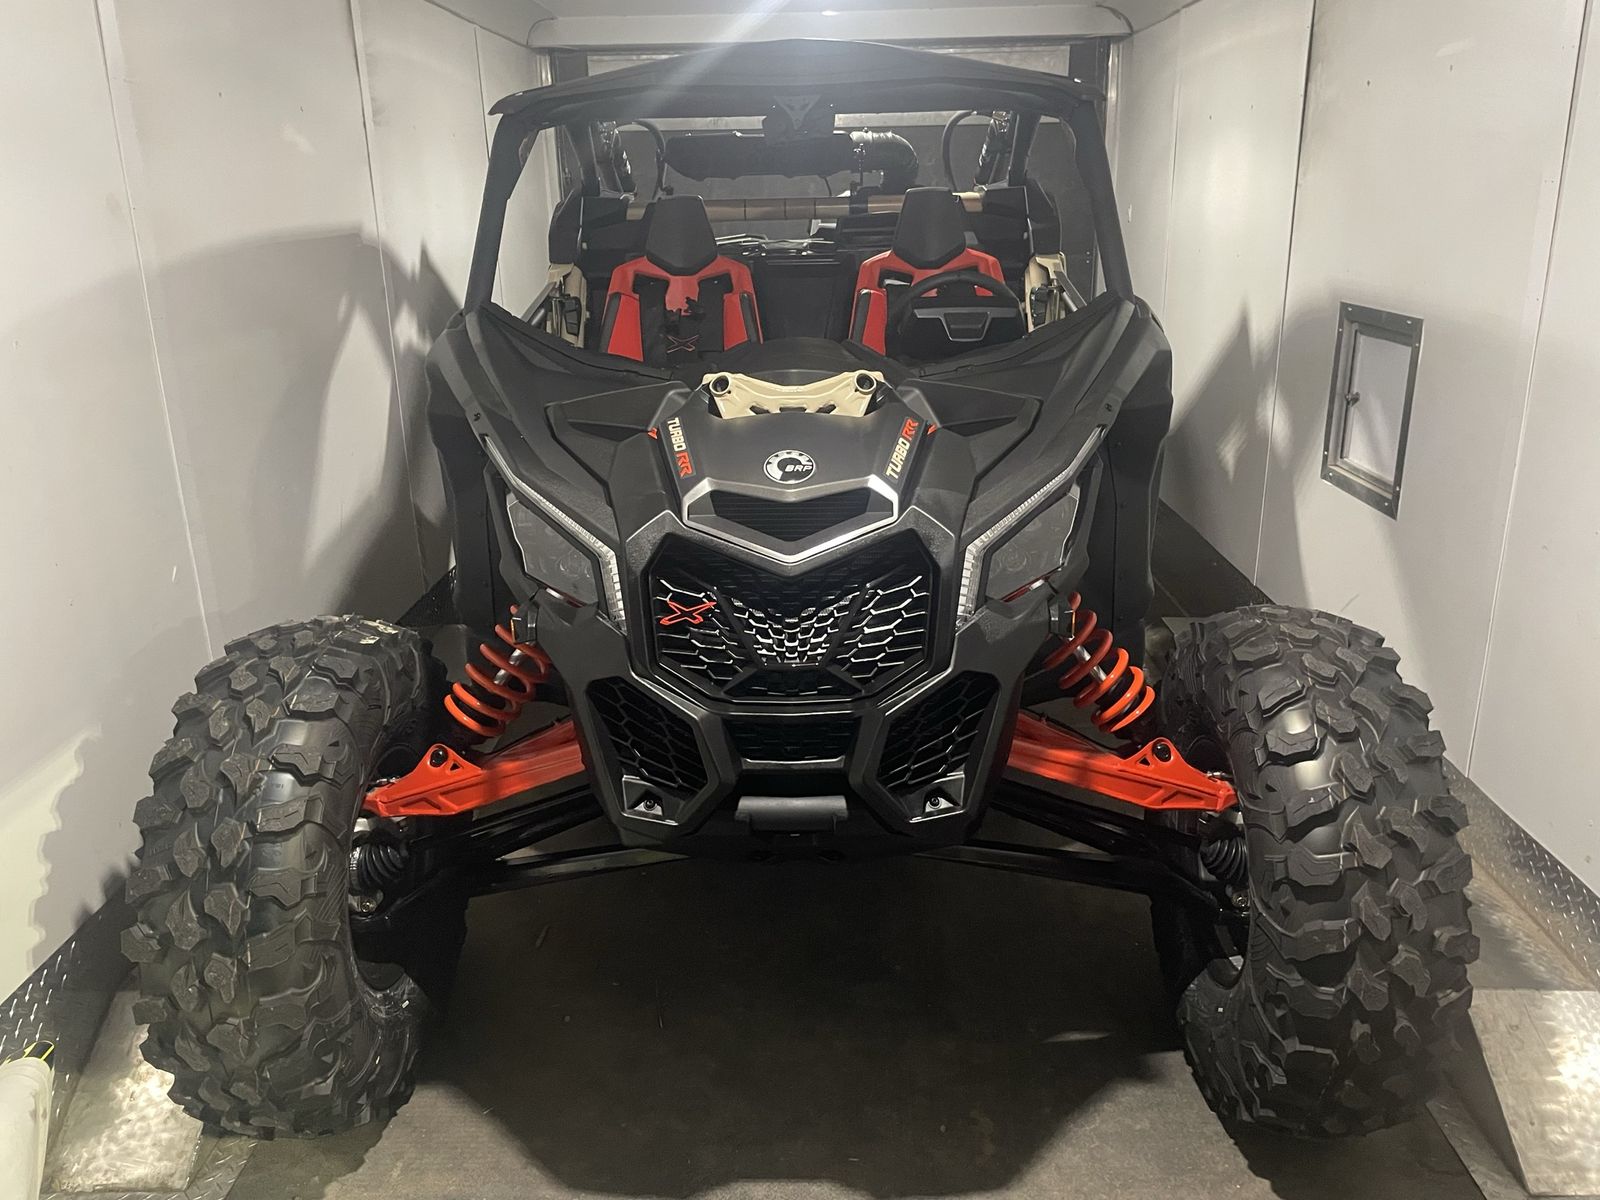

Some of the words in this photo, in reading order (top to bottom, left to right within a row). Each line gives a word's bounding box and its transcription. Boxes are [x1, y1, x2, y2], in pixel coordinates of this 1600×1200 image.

[667, 417, 687, 452] TURBO
[785, 464, 813, 472] BRP
[885, 437, 910, 479] TURBO
